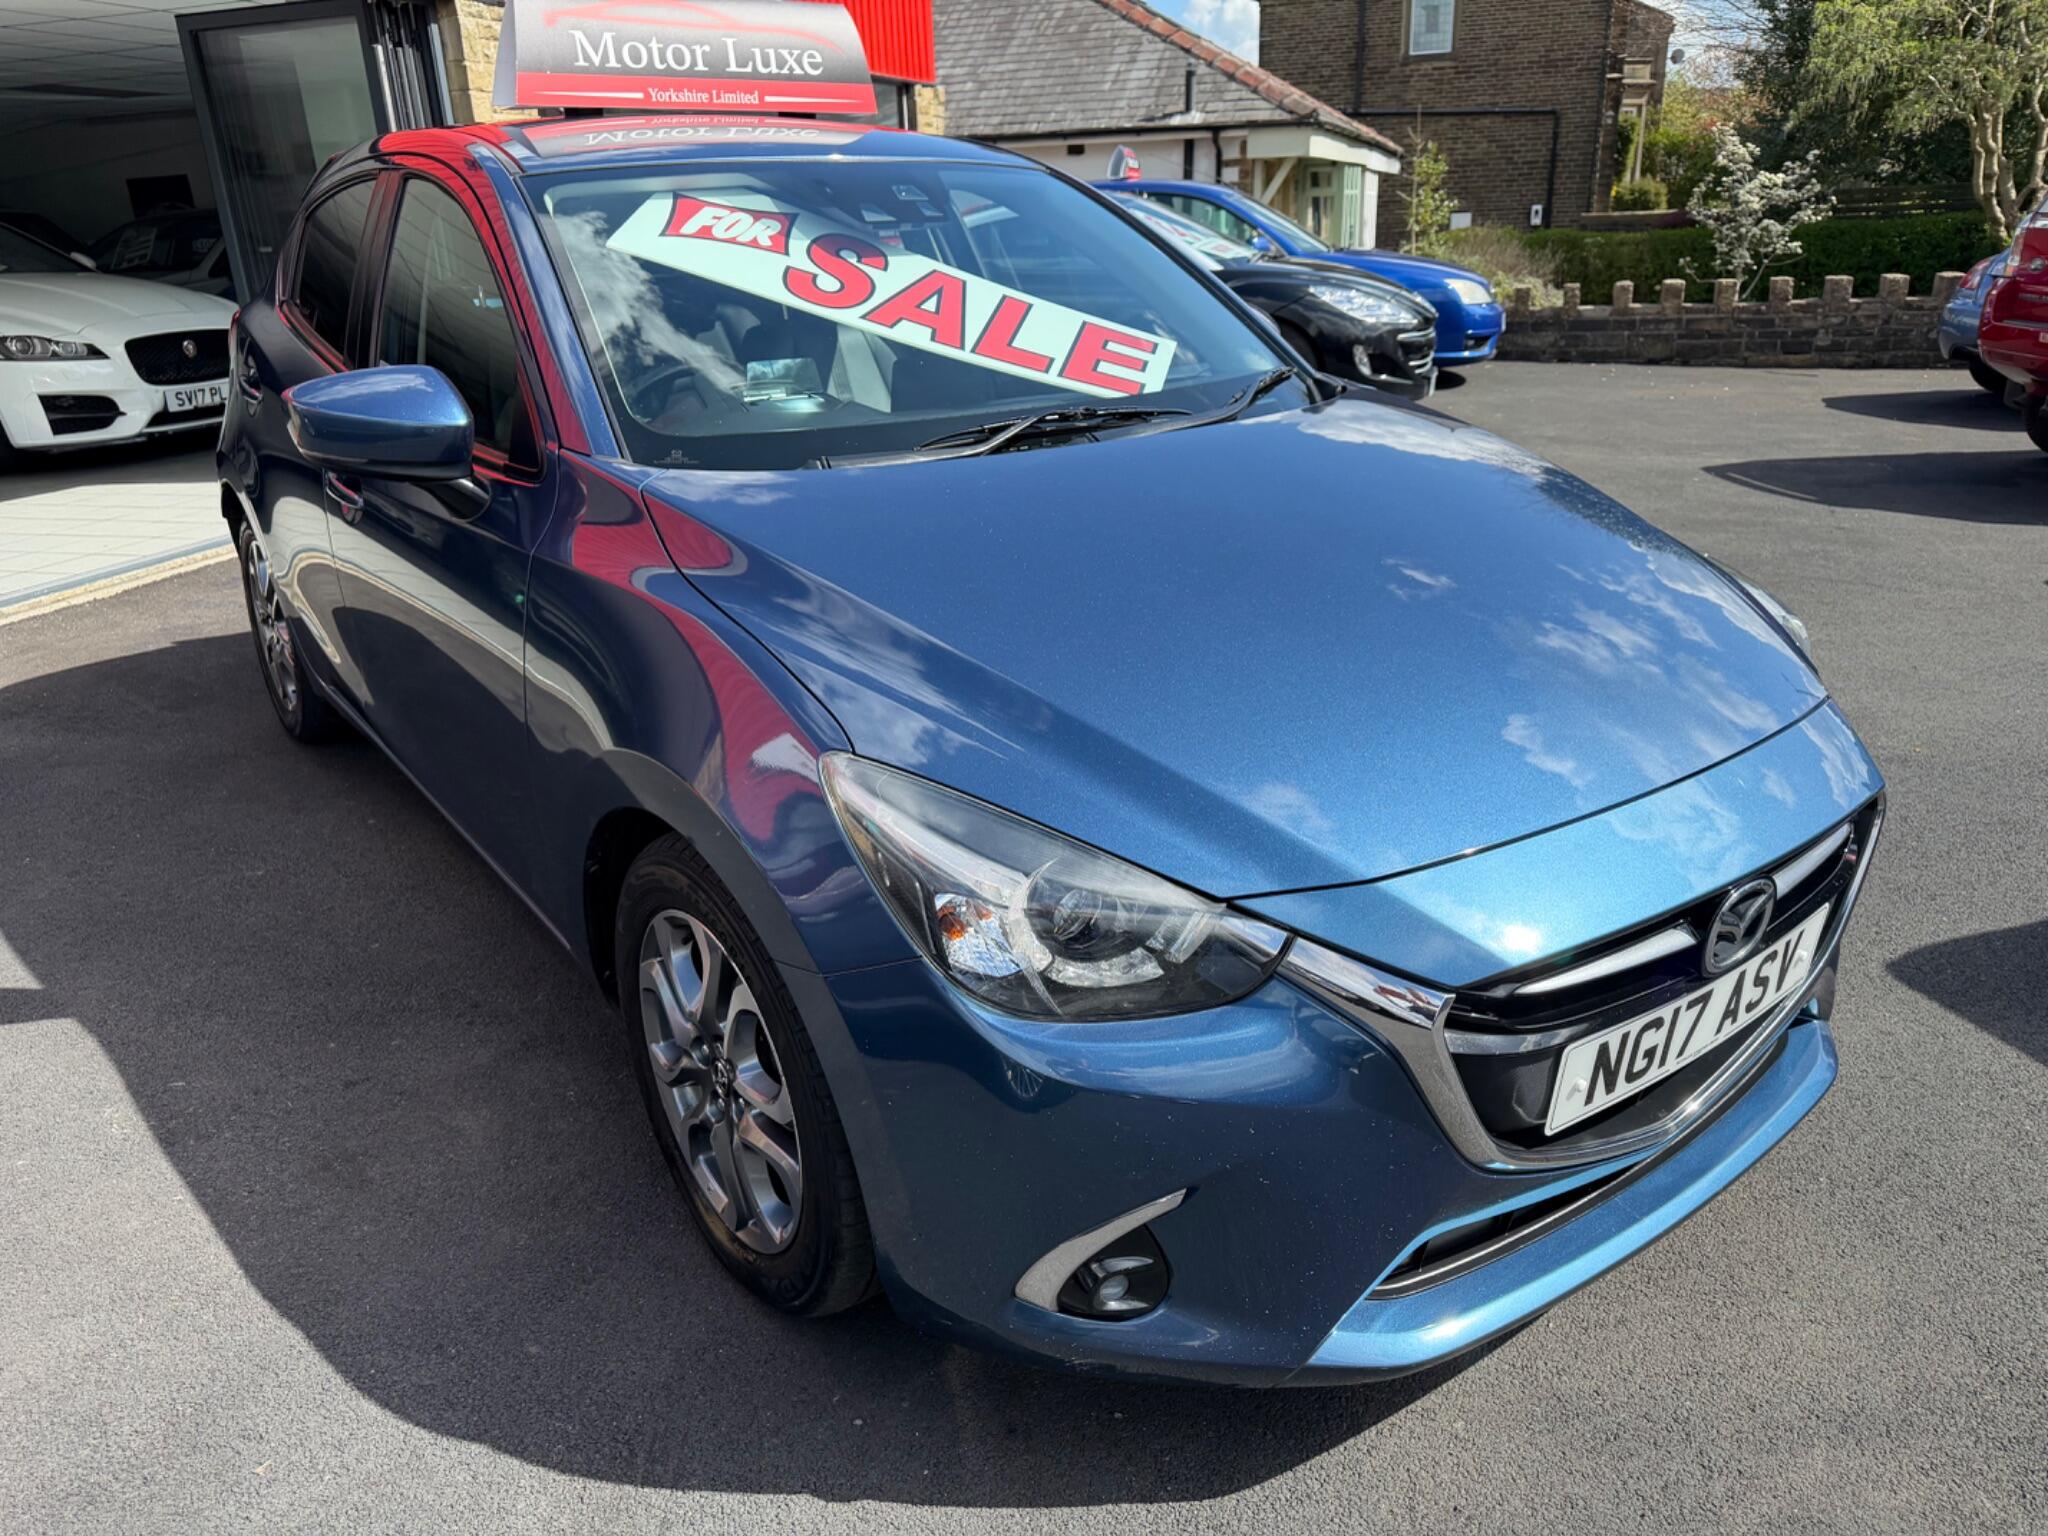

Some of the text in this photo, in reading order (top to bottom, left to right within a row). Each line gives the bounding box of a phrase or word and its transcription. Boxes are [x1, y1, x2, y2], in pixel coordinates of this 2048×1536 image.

[568, 29, 824, 76] Motor Luxe
[648, 87, 760, 105] Yorkshire Limited
[680, 206, 784, 247] FOR
[783, 232, 1159, 396] SALE
[175, 388, 206, 407] SV17
[1584, 929, 1805, 1107] NG17 ASV
